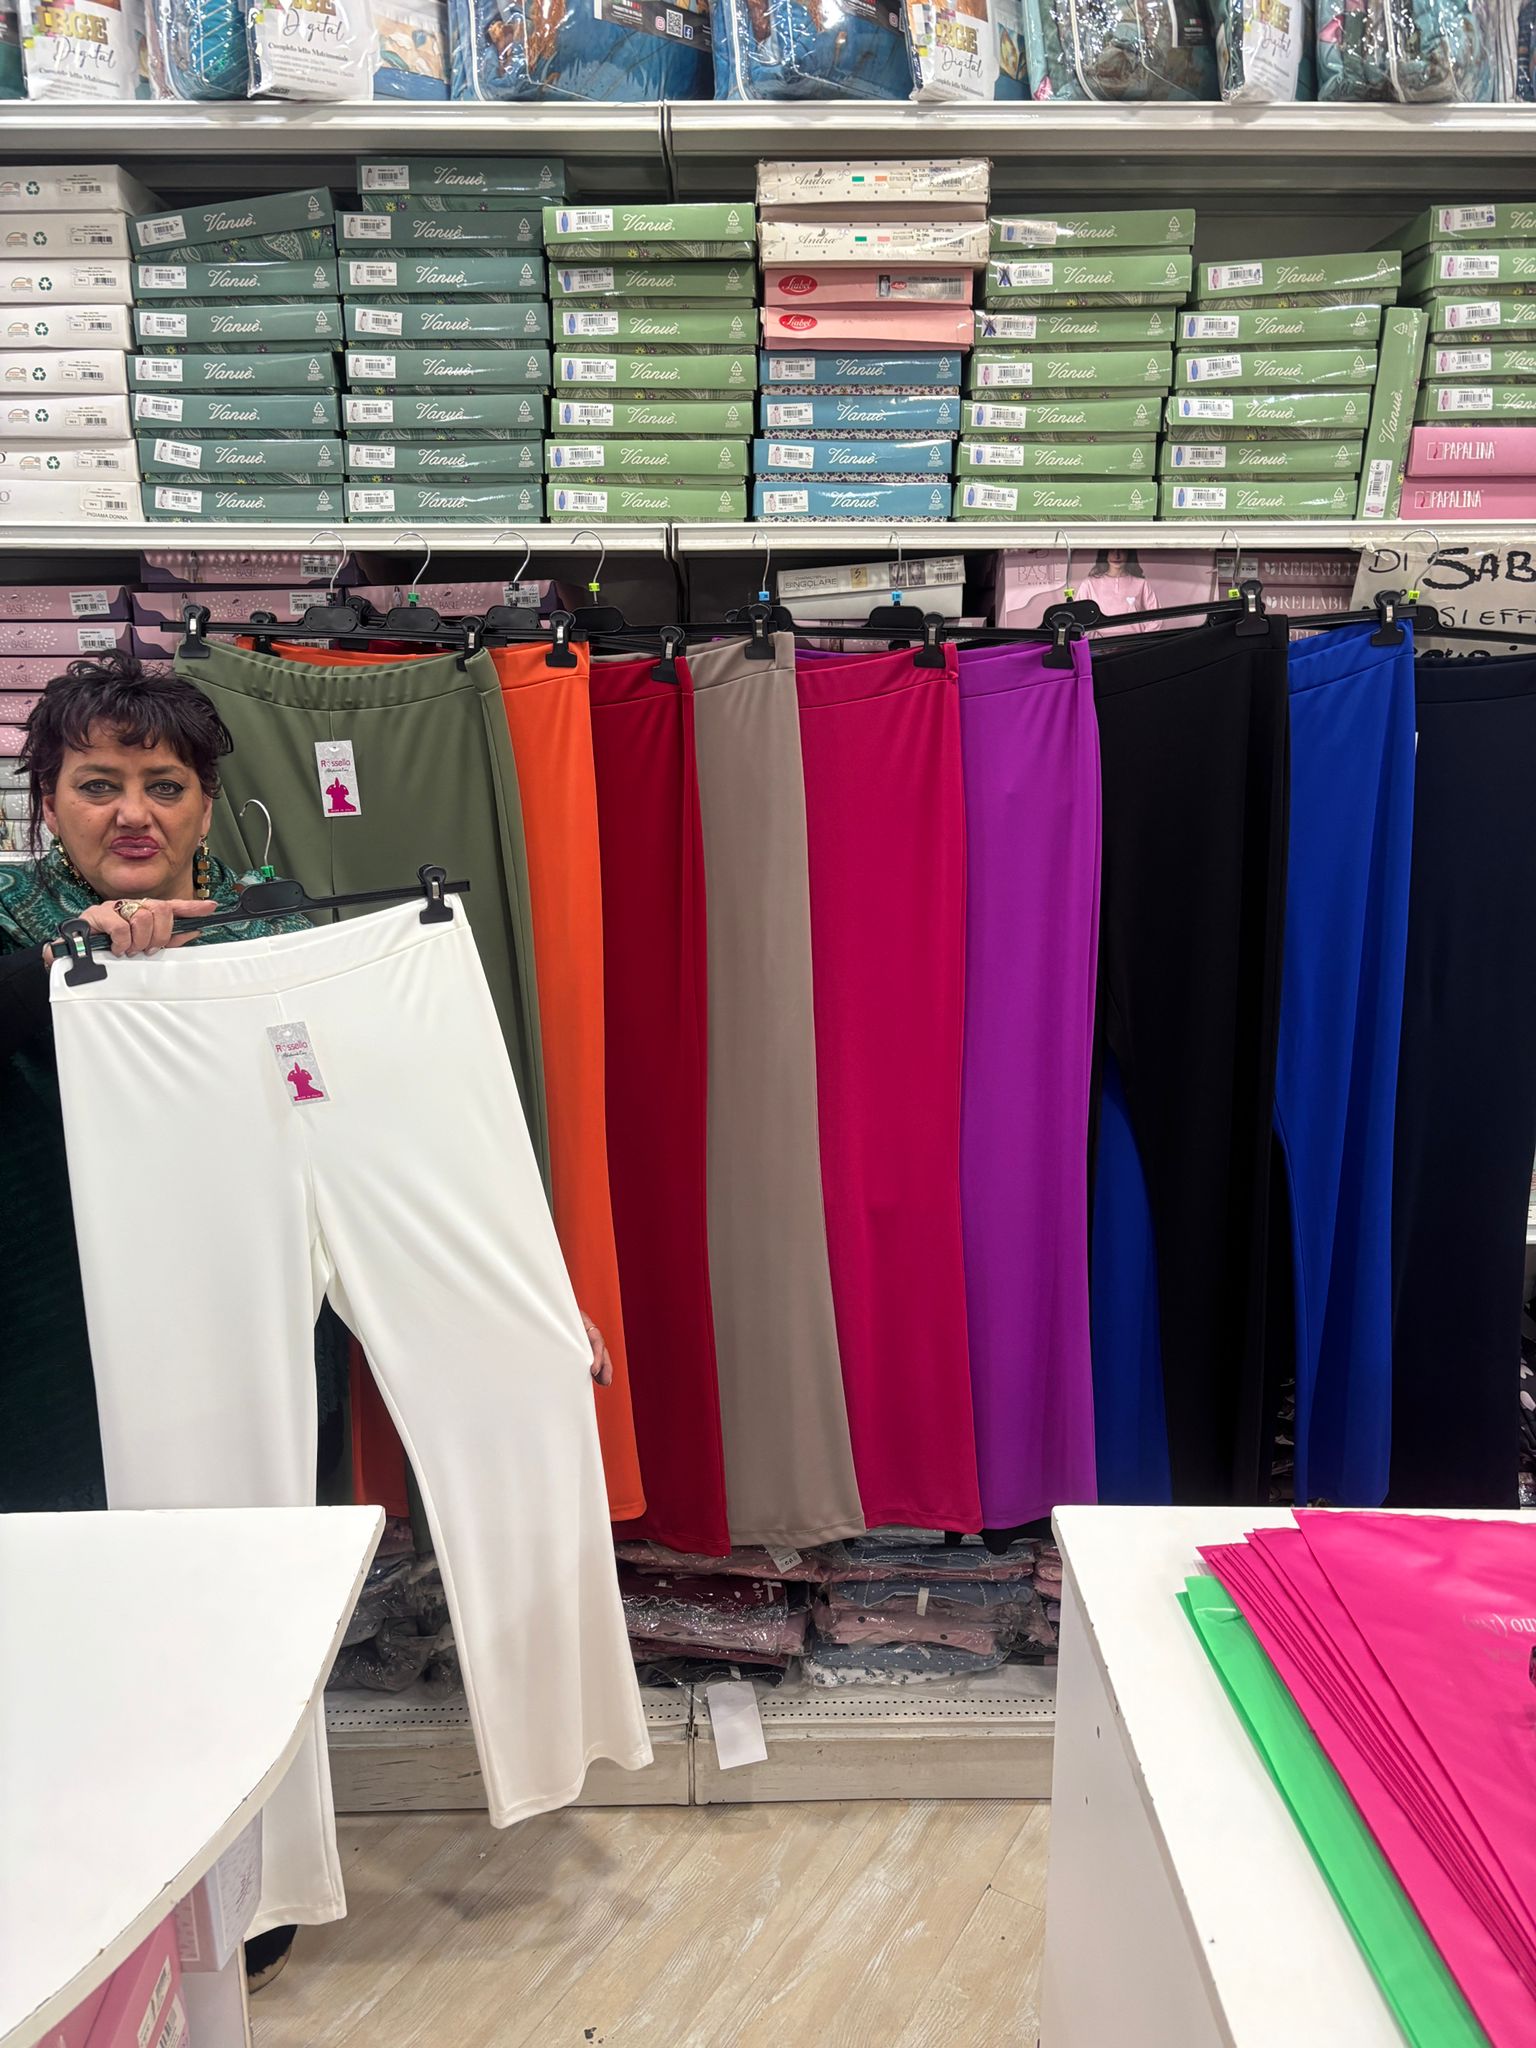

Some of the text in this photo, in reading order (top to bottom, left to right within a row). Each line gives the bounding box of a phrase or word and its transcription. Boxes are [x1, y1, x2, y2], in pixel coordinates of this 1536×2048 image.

[283, 8, 345, 42] Dgital
[1444, 442, 1495, 460] PAPALINA
[1431, 491, 1482, 508] PAPALINA
[1280, 595, 1350, 610] RELIABL
